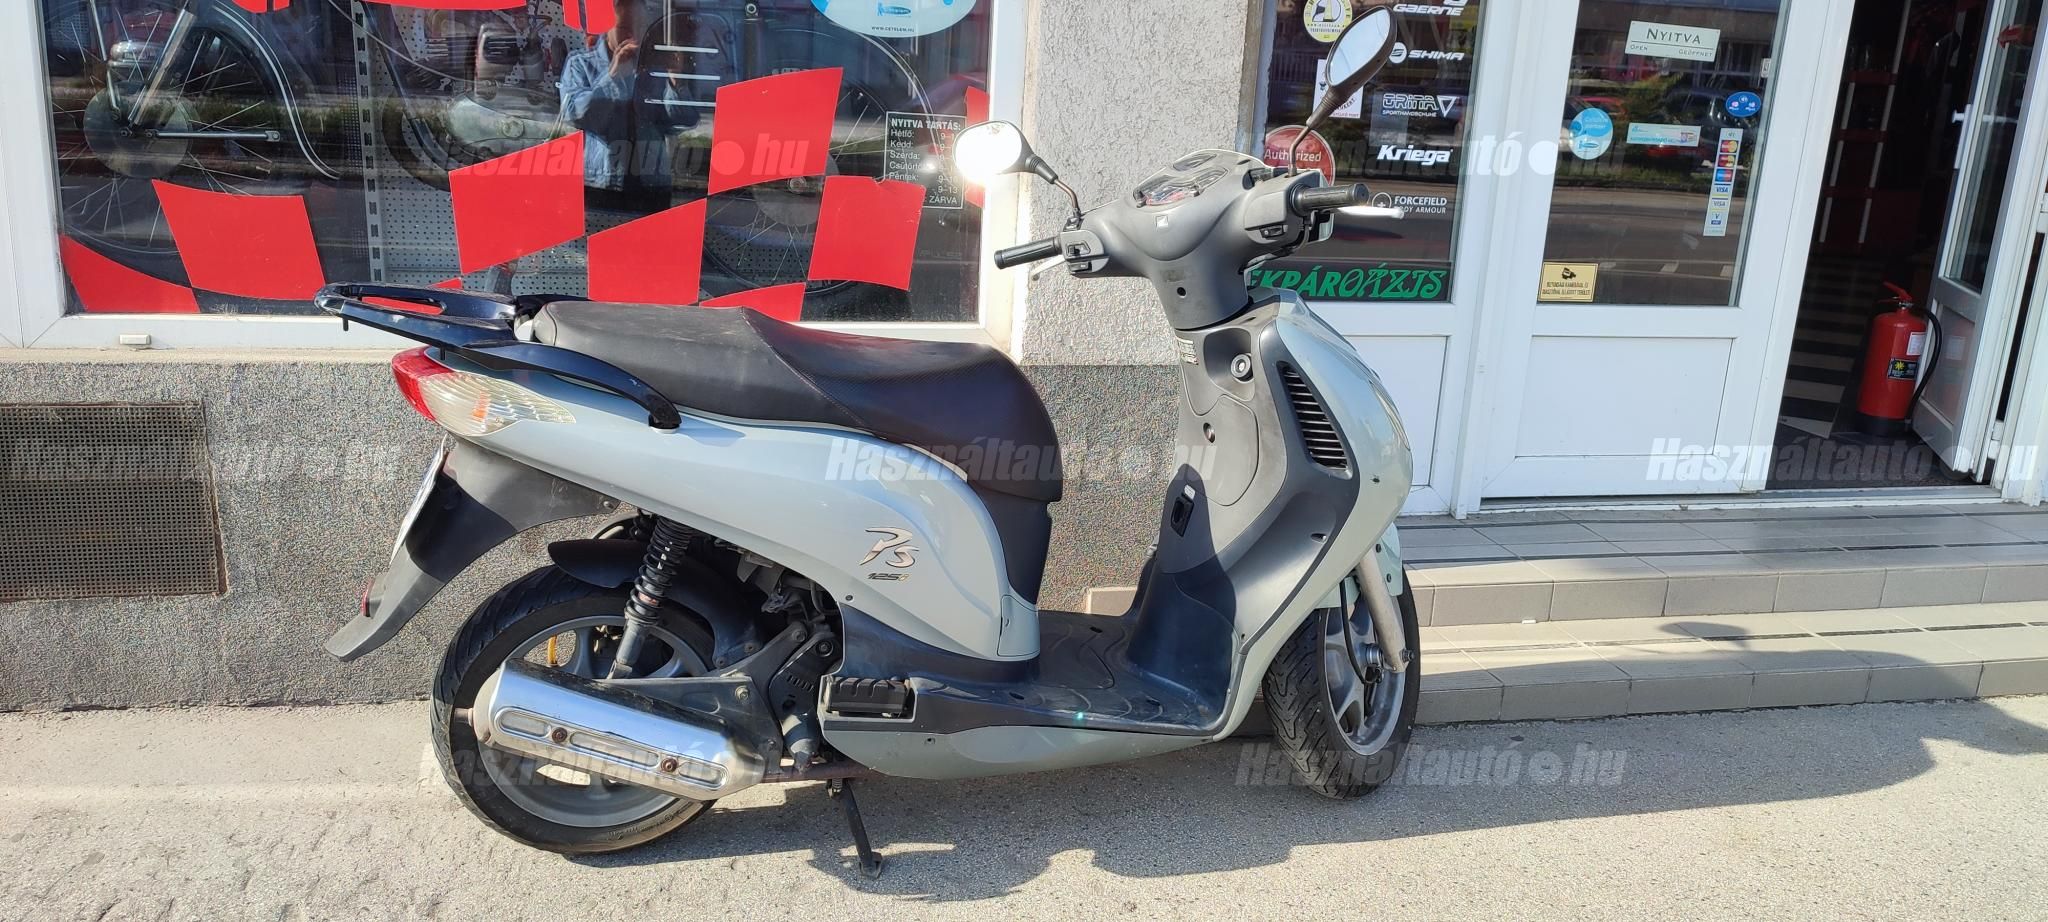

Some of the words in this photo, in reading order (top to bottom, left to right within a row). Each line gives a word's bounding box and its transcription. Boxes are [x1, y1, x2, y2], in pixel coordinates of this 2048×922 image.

[1393, 3, 1464, 16] GAERNE
[1646, 28, 1701, 44] NYITVA
[1408, 49, 1464, 60] SHIMA
[891, 118, 923, 129] NYITVA
[926, 120, 961, 131] TARTÁS:
[890, 129, 915, 138] Hétfő:
[890, 140, 914, 148] Kedd:
[889, 151, 920, 160] Szerda:
[1264, 149, 1322, 162] Authrized
[1377, 145, 1451, 166] Kriega
[929, 192, 958, 204] ZÁRVA
[1394, 196, 1447, 206] FORCEFIELD
[1415, 206, 1446, 214] ARMOUR
